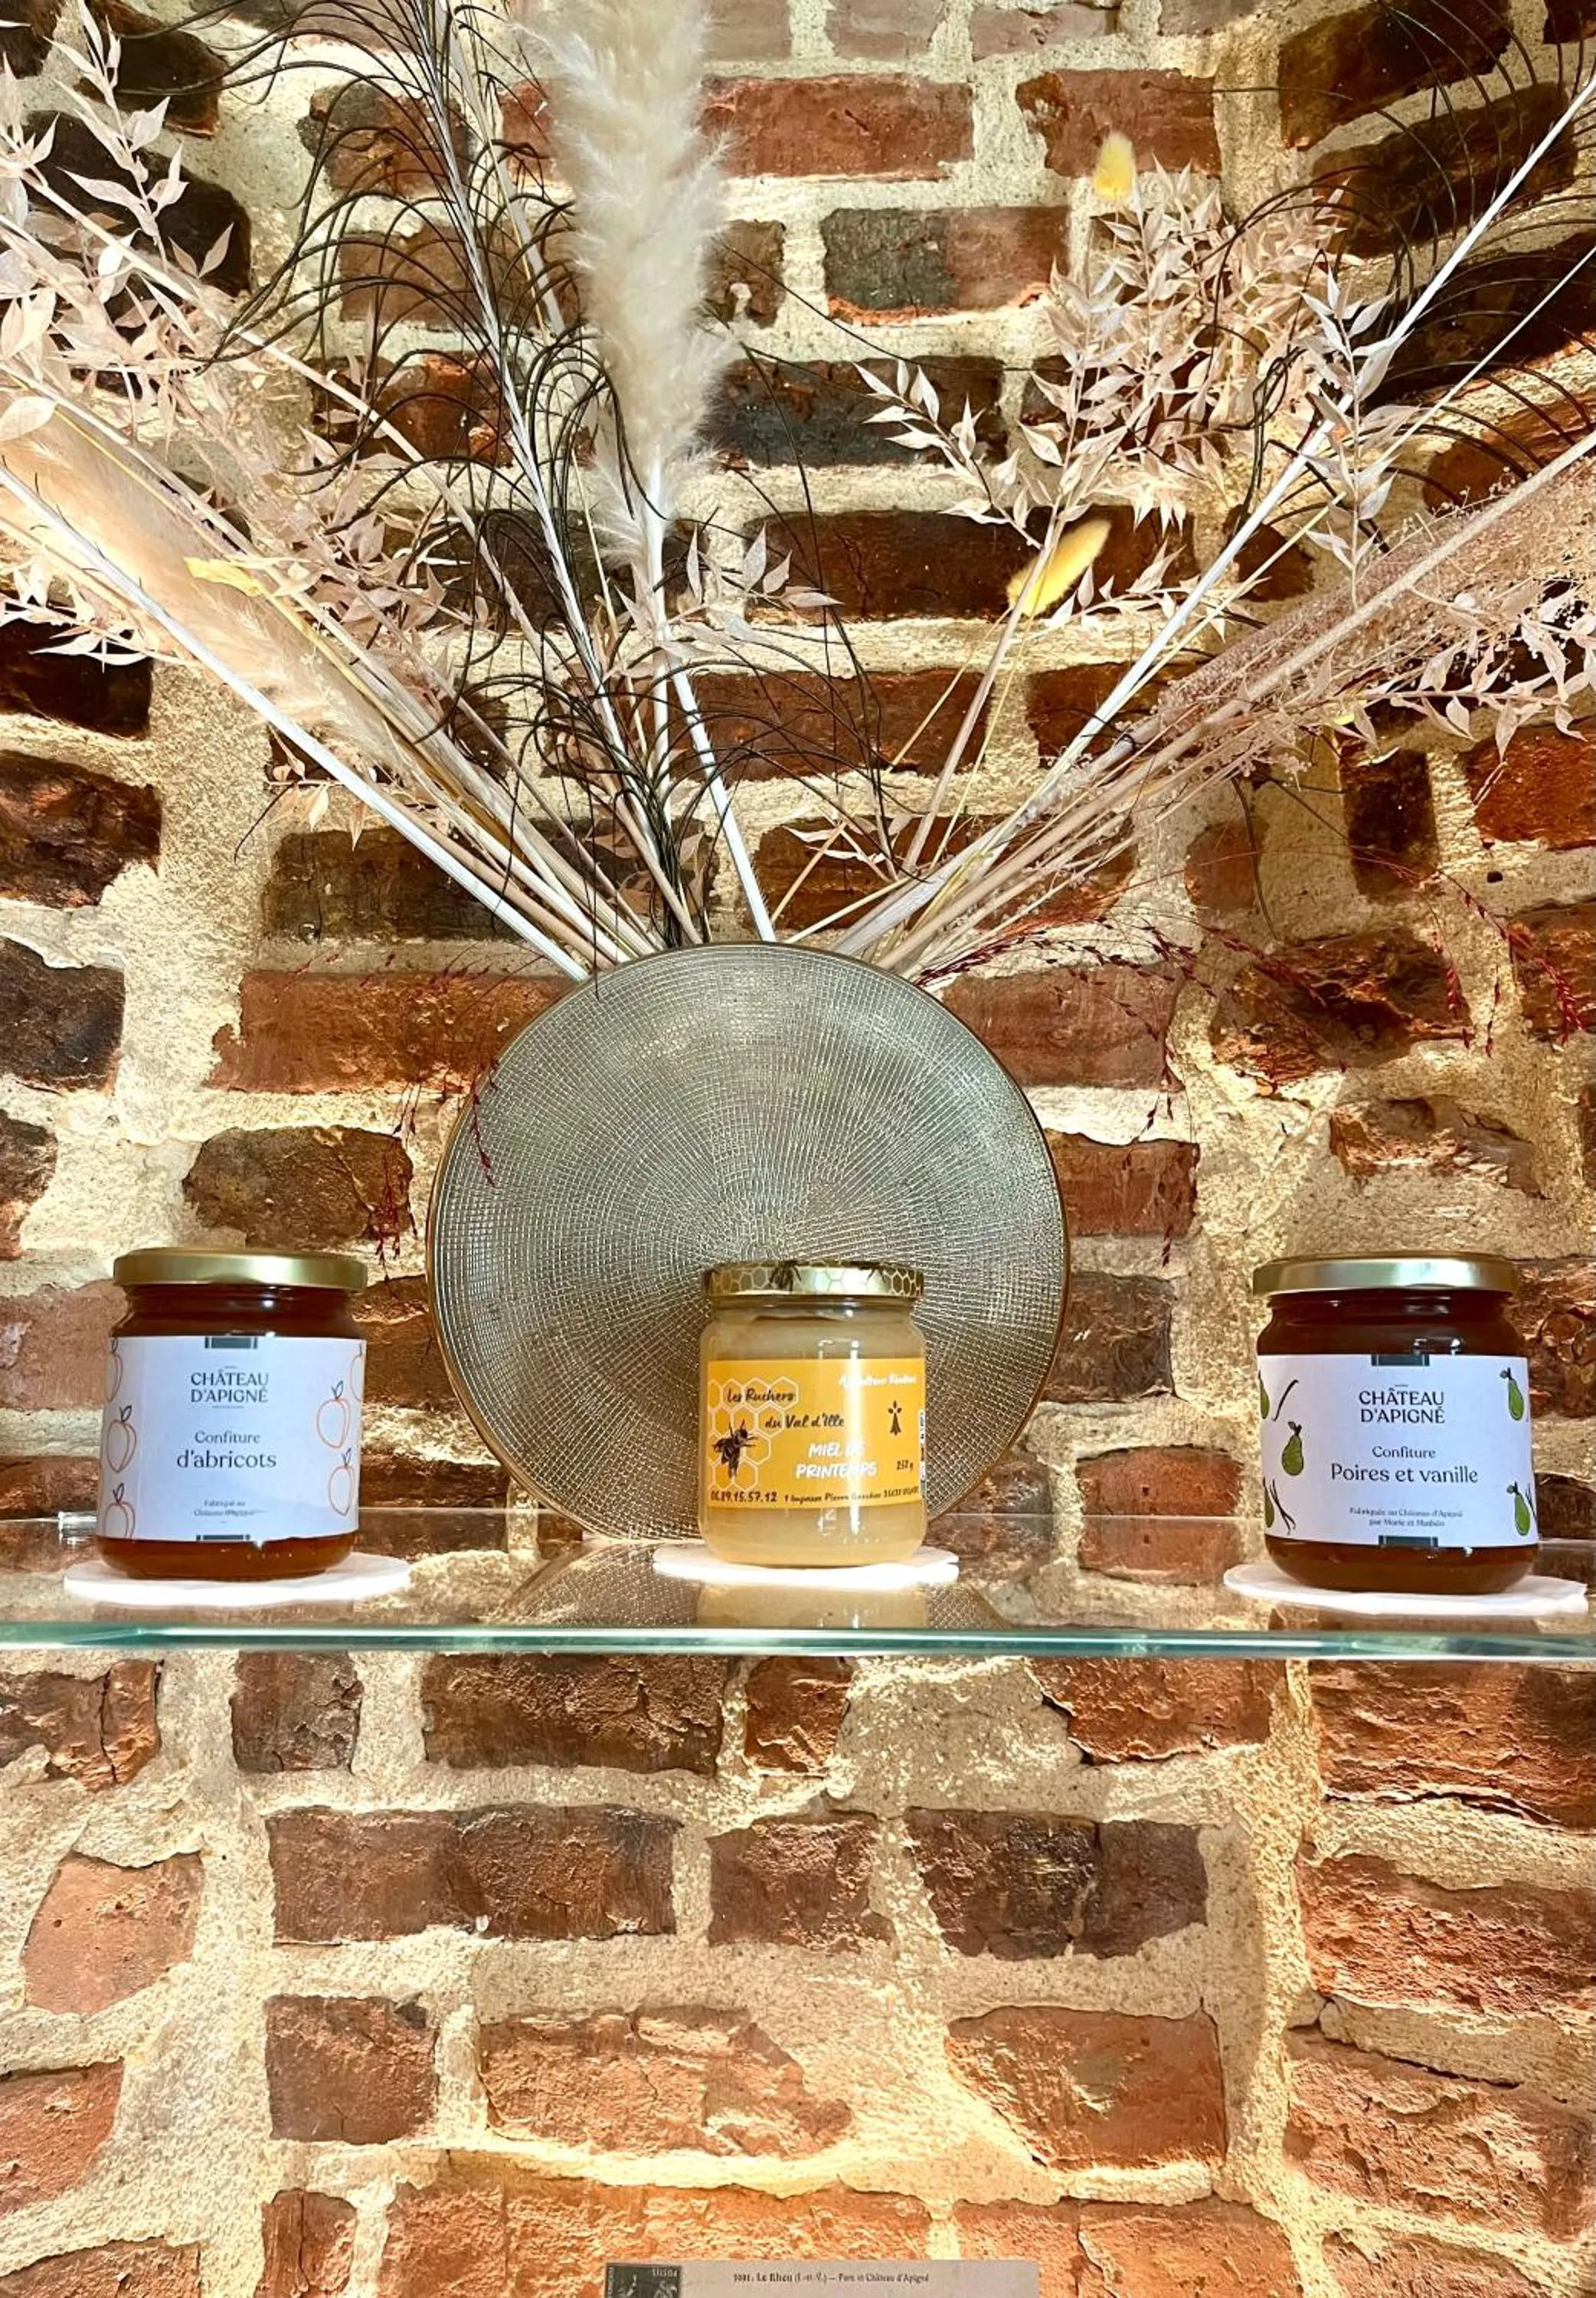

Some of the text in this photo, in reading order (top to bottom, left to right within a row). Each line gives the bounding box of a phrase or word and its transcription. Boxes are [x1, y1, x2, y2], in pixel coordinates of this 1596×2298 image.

[191, 1370, 269, 1386] CHÂTEAU
[191, 1386, 269, 1403] D'APIGNÉ
[744, 1387, 795, 1403] Ruchers
[1359, 1387, 1444, 1406] CHÂTEAU
[765, 1416, 783, 1429] du
[783, 1416, 809, 1429] Val
[1360, 1406, 1446, 1424] D'APIGNÉ
[195, 1430, 261, 1444] Confiture
[809, 1442, 842, 1458] MIEL
[1372, 1445, 1437, 1459] Confiture
[177, 1450, 277, 1468] d'abricots
[1331, 1463, 1479, 1484] Poires et vanille
[756, 2273, 767, 2282] Le
